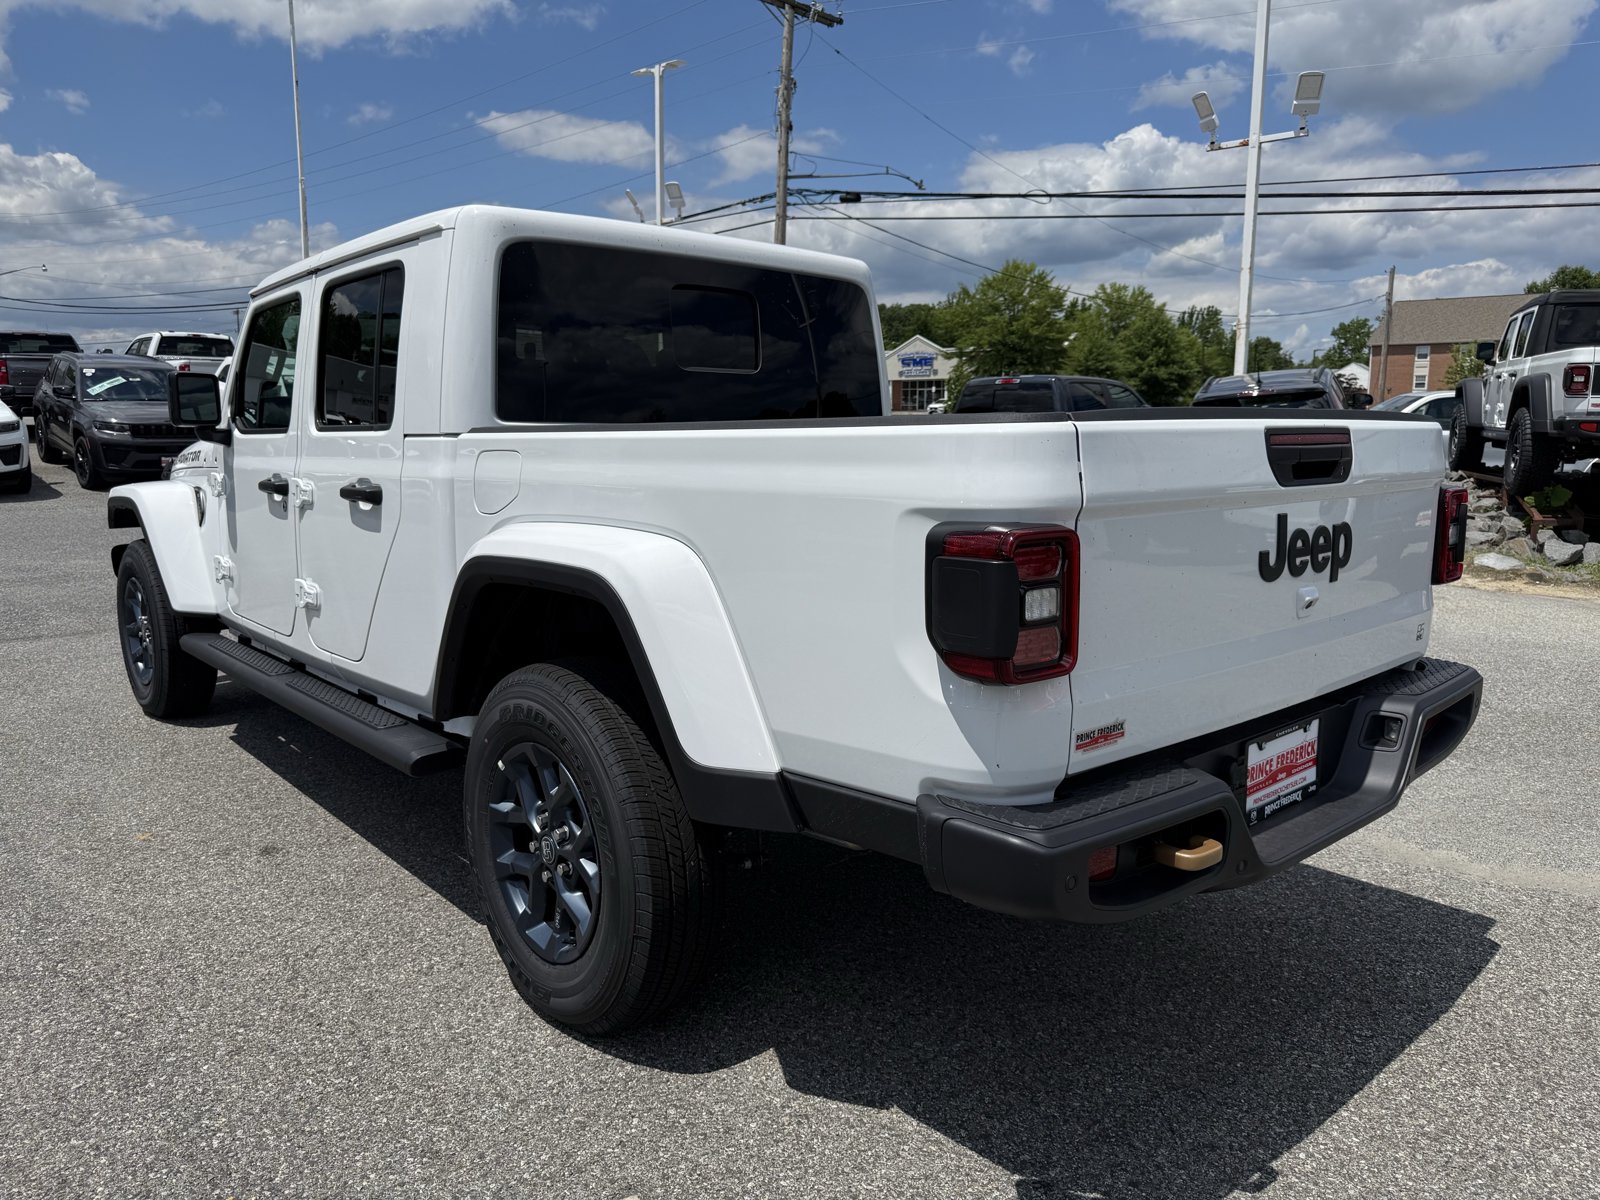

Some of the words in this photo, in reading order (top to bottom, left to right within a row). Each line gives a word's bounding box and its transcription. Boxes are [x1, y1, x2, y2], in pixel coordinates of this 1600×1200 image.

[1258, 513, 1352, 583] Jeep
[1077, 730, 1096, 743] PRINCE
[1097, 722, 1124, 736] FREDERICK
[1275, 724, 1300, 738] CHRYSLER
[1246, 757, 1274, 784] PRINCE
[1275, 739, 1316, 768] FREDERICK
[1276, 771, 1288, 781] Jeep
[1264, 800, 1281, 819] PRINCE
[1280, 789, 1303, 808] FREDERICK
